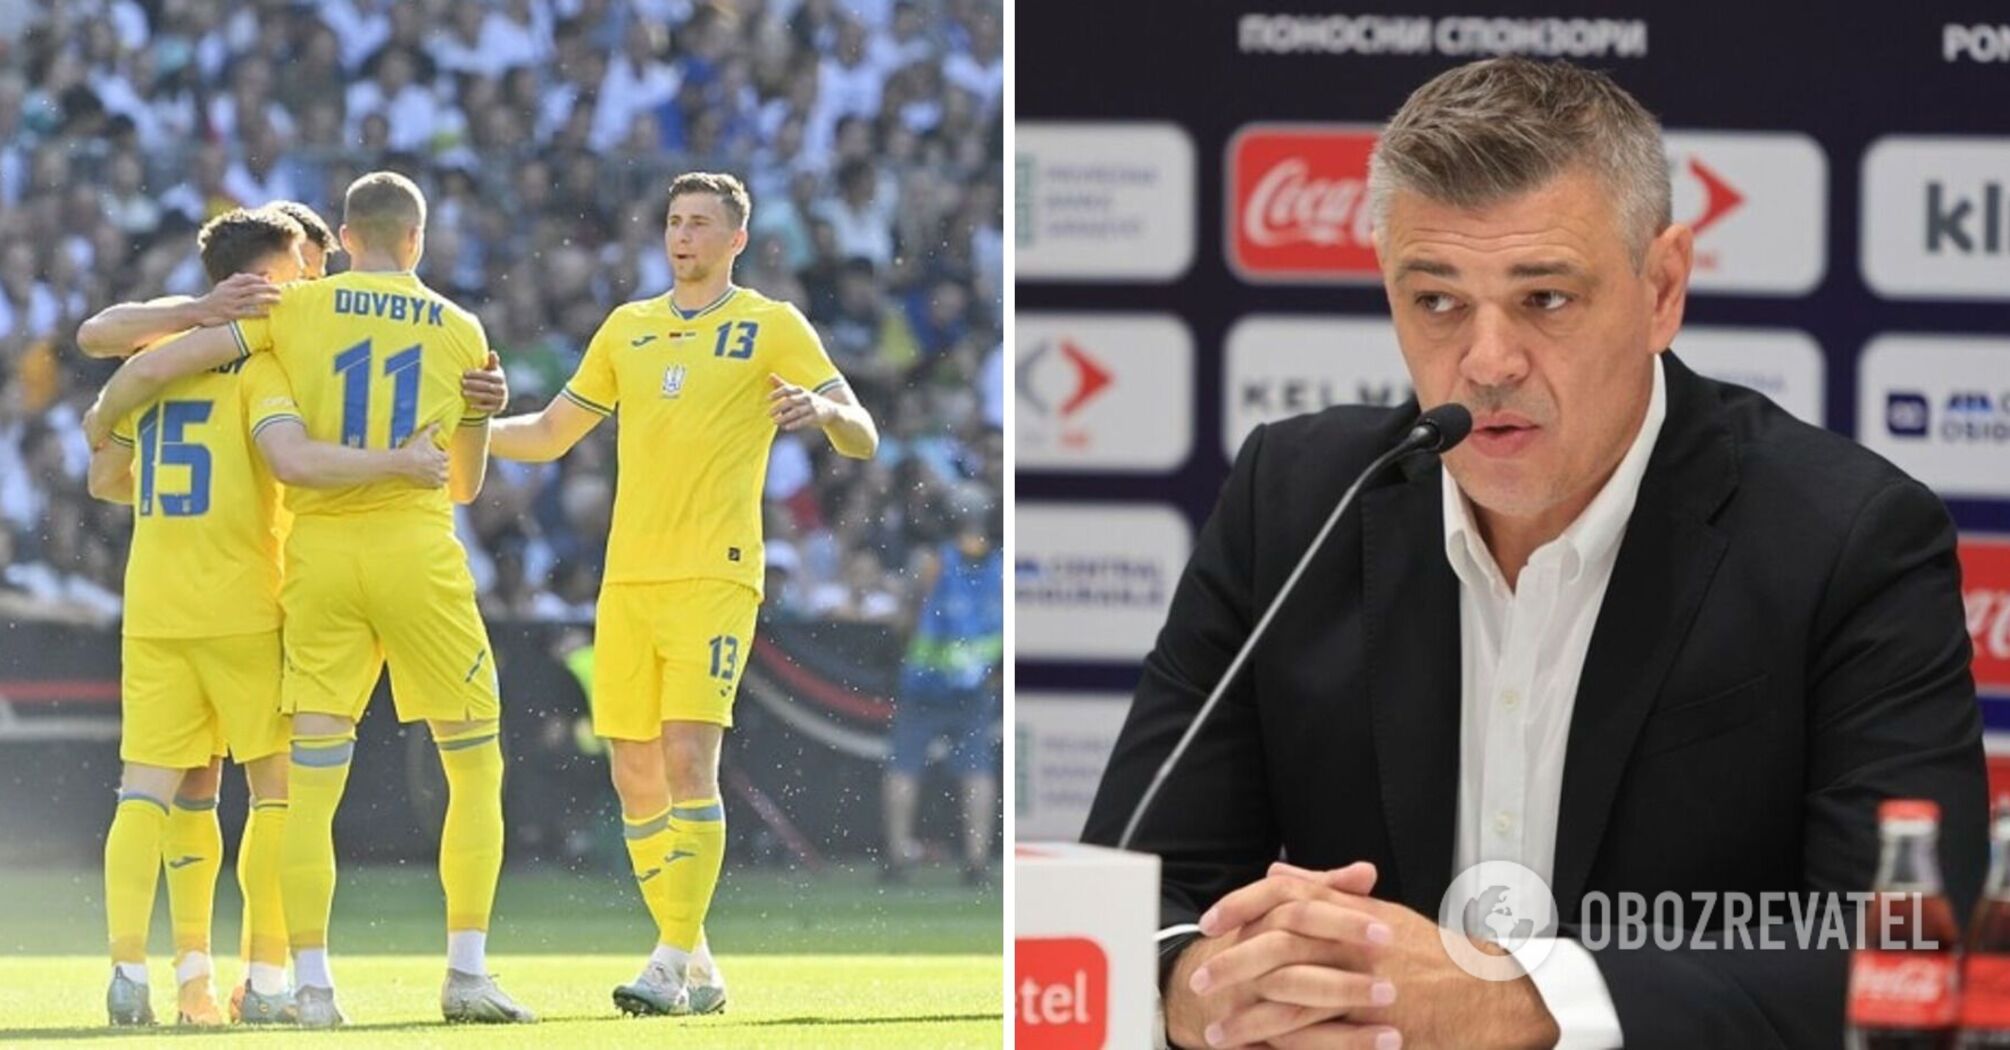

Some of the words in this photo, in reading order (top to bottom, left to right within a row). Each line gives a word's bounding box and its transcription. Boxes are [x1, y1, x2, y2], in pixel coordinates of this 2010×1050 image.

[1238, 14, 1432, 54] ПОНОСНИ
[1435, 16, 1647, 57] СПОНЗОРИ
[1243, 157, 1376, 247] Coca
[1926, 182, 2010, 253] kl
[334, 288, 444, 327] DOVBYK
[714, 321, 758, 359] 13
[333, 337, 422, 449] 11
[137, 400, 214, 517] 15
[709, 634, 738, 680] 13
